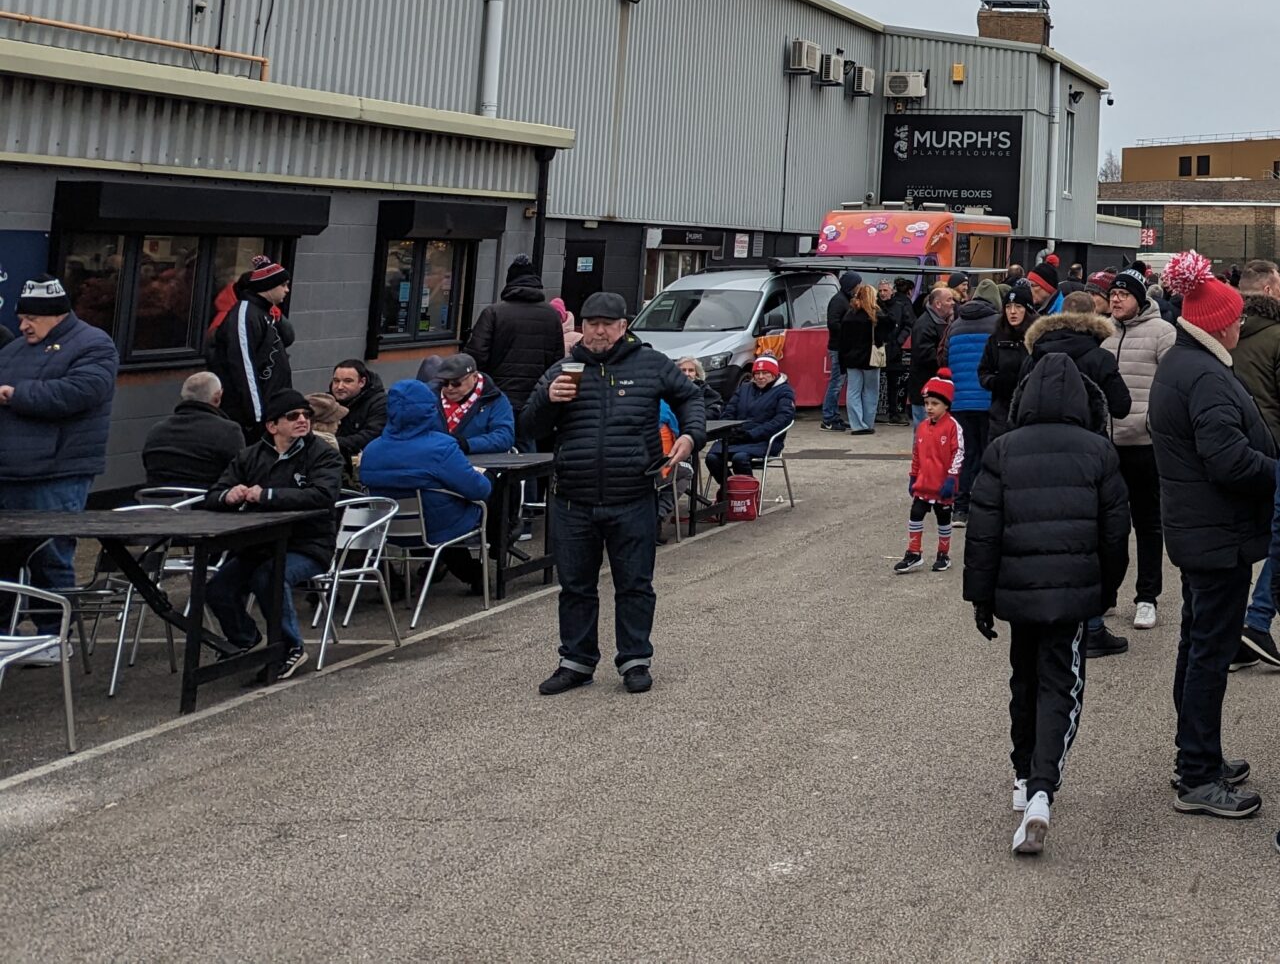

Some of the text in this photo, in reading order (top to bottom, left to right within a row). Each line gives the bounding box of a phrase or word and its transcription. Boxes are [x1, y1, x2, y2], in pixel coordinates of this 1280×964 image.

[913, 131, 1010, 149] MURPH'S
[966, 150, 1011, 158] LOUNGE
[907, 189, 992, 199] EXECUTIVE BOXES
[1141, 229, 1154, 237] 24
[1141, 237, 1154, 246] 25
